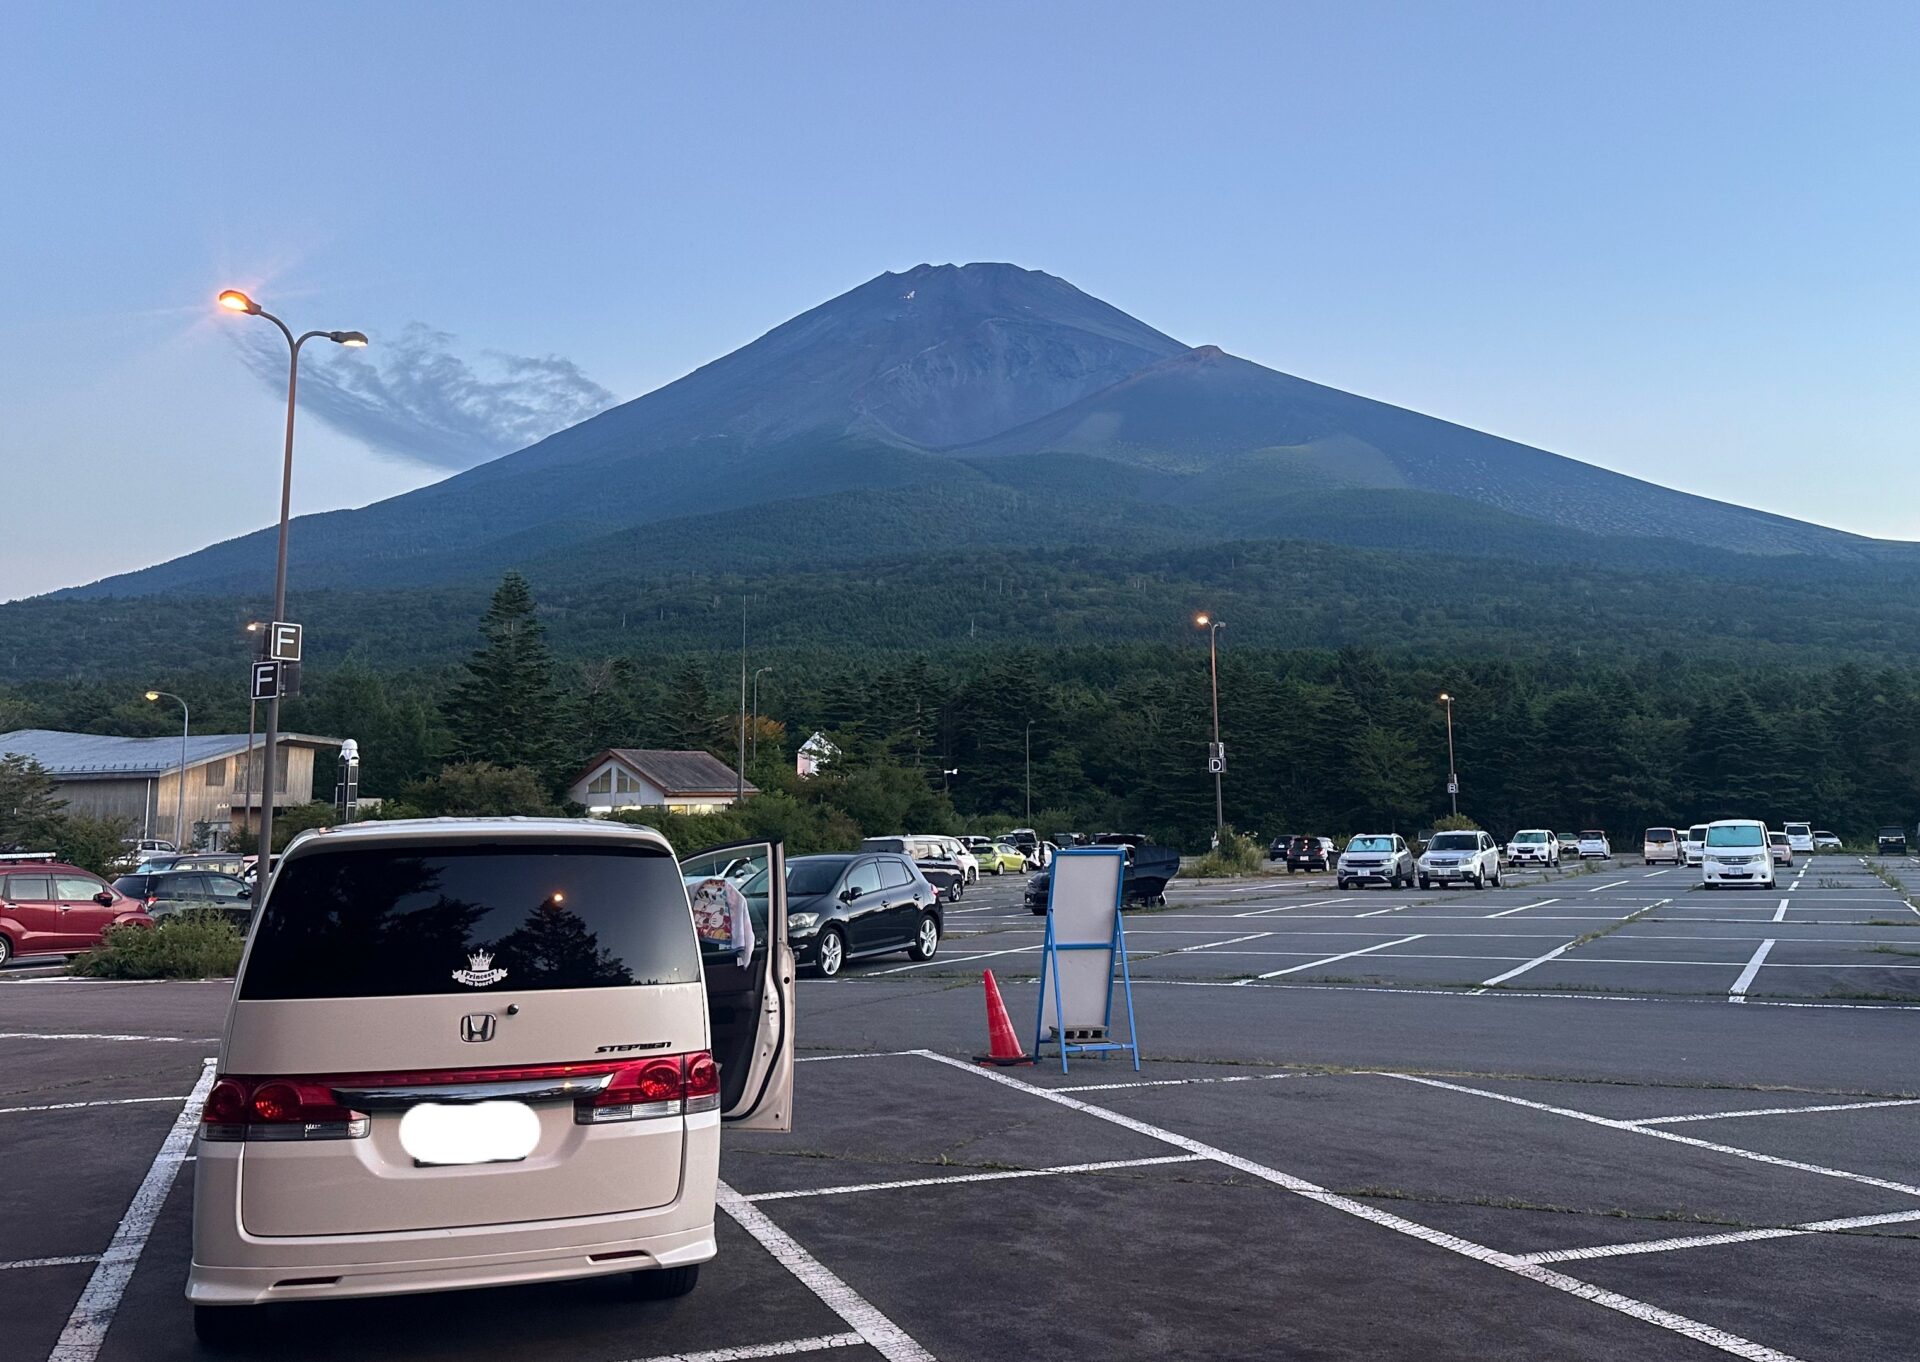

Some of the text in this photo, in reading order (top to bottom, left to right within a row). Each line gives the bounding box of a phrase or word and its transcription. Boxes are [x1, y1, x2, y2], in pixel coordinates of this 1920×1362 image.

[276, 627, 296, 656] F
[255, 665, 275, 696] F
[1211, 759, 1222, 771] D
[465, 970, 495, 980] Princess
